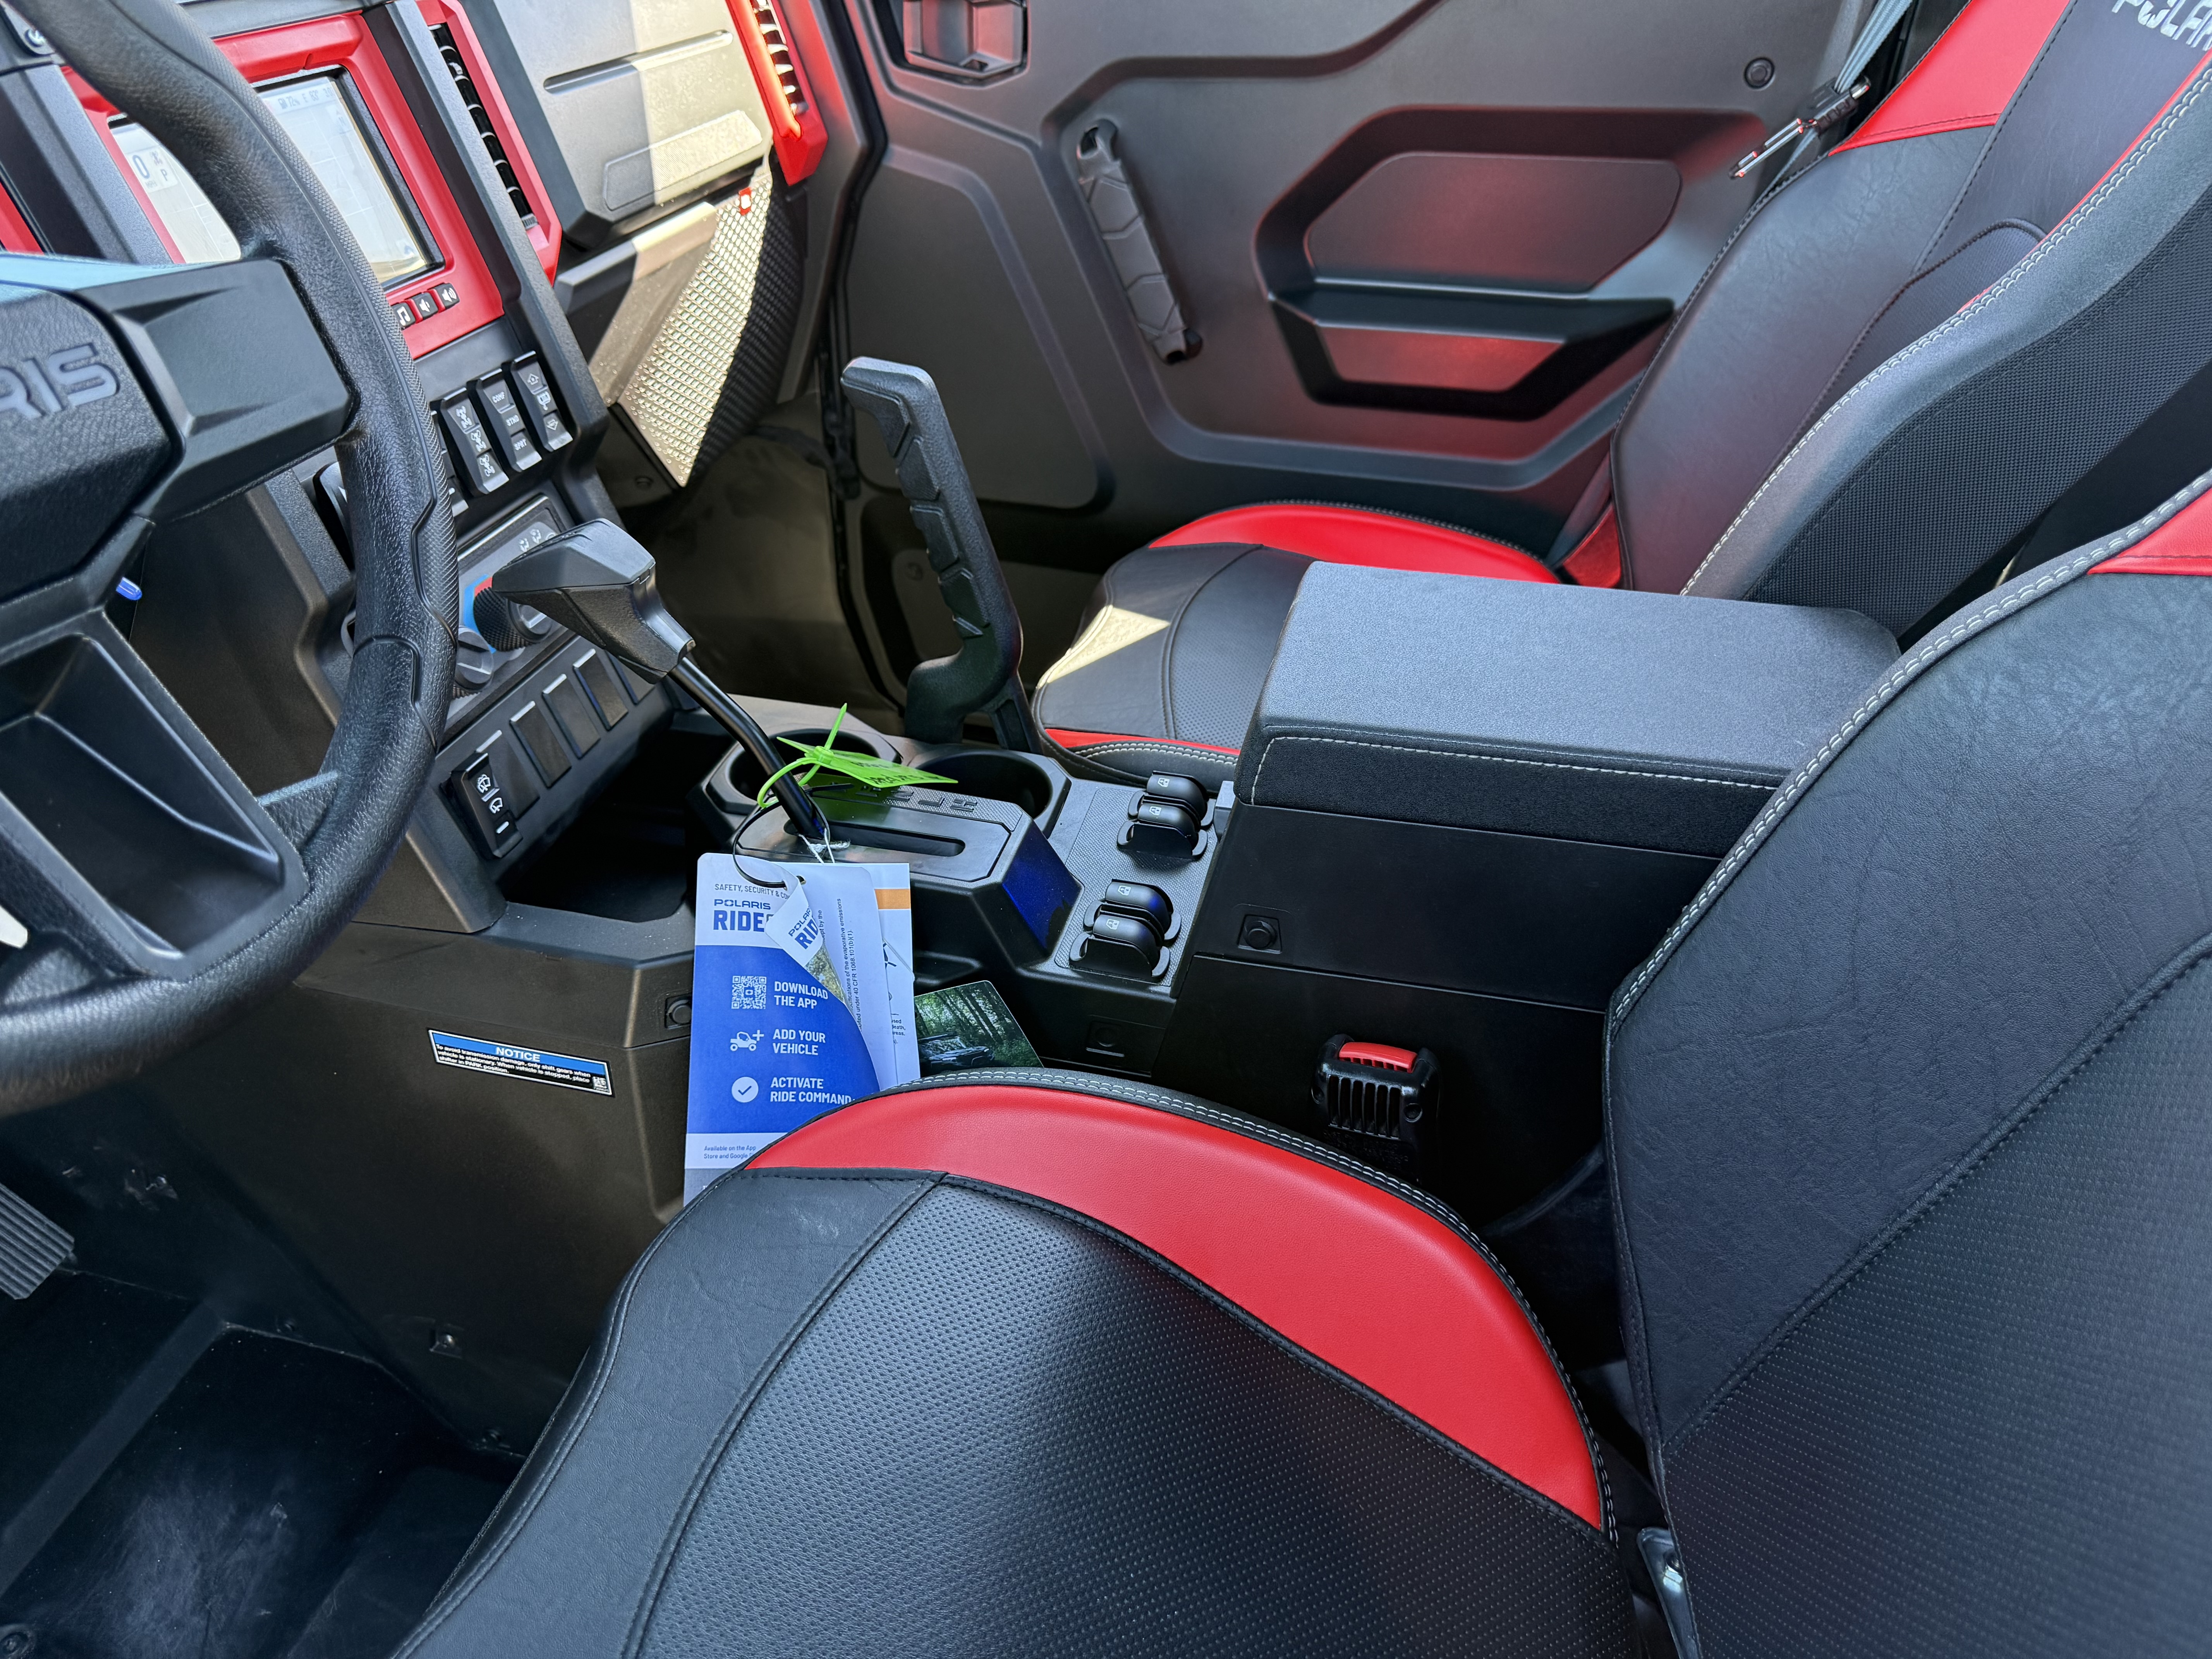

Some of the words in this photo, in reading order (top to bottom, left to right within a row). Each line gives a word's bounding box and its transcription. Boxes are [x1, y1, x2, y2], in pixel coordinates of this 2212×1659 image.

[160, 169, 168, 181] P
[714, 884, 743, 892] SAFETY,
[744, 886, 774, 895] SECURITY
[714, 899, 771, 910] POLARIS
[775, 981, 828, 1000] DOWNLOAD
[774, 995, 795, 1006] THE
[797, 998, 817, 1009] APP
[773, 1029, 796, 1039] ADD
[799, 1030, 826, 1043] YOUR
[496, 1047, 540, 1062] NOTICE
[773, 1043, 818, 1055] VEHICLE
[461, 1049, 500, 1061] transmission
[500, 1057, 527, 1066] damage,
[465, 1056, 496, 1066] stationary.
[483, 1065, 509, 1073] position.
[770, 1077, 824, 1089] ACTIVATE
[770, 1091, 796, 1102] RIDE
